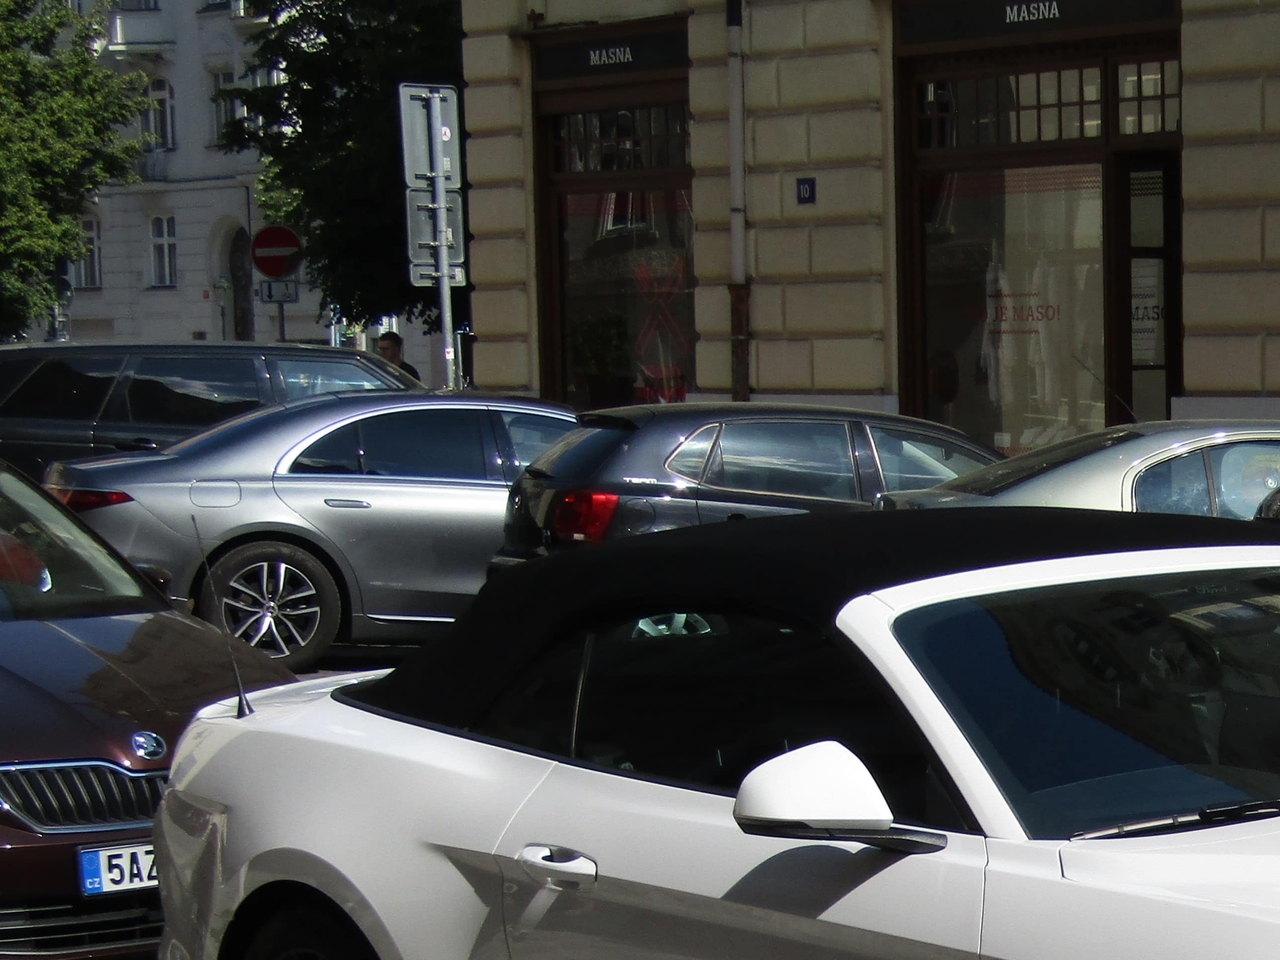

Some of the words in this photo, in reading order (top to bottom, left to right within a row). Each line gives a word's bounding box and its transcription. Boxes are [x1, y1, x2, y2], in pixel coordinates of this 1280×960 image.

[1005, 0, 1060, 23] MASNA
[589, 46, 633, 65] MASNA
[800, 184, 810, 198] 10
[1011, 305, 1061, 322] MASO!
[107, 850, 158, 886] 5AZ
[86, 878, 101, 888] CZ
